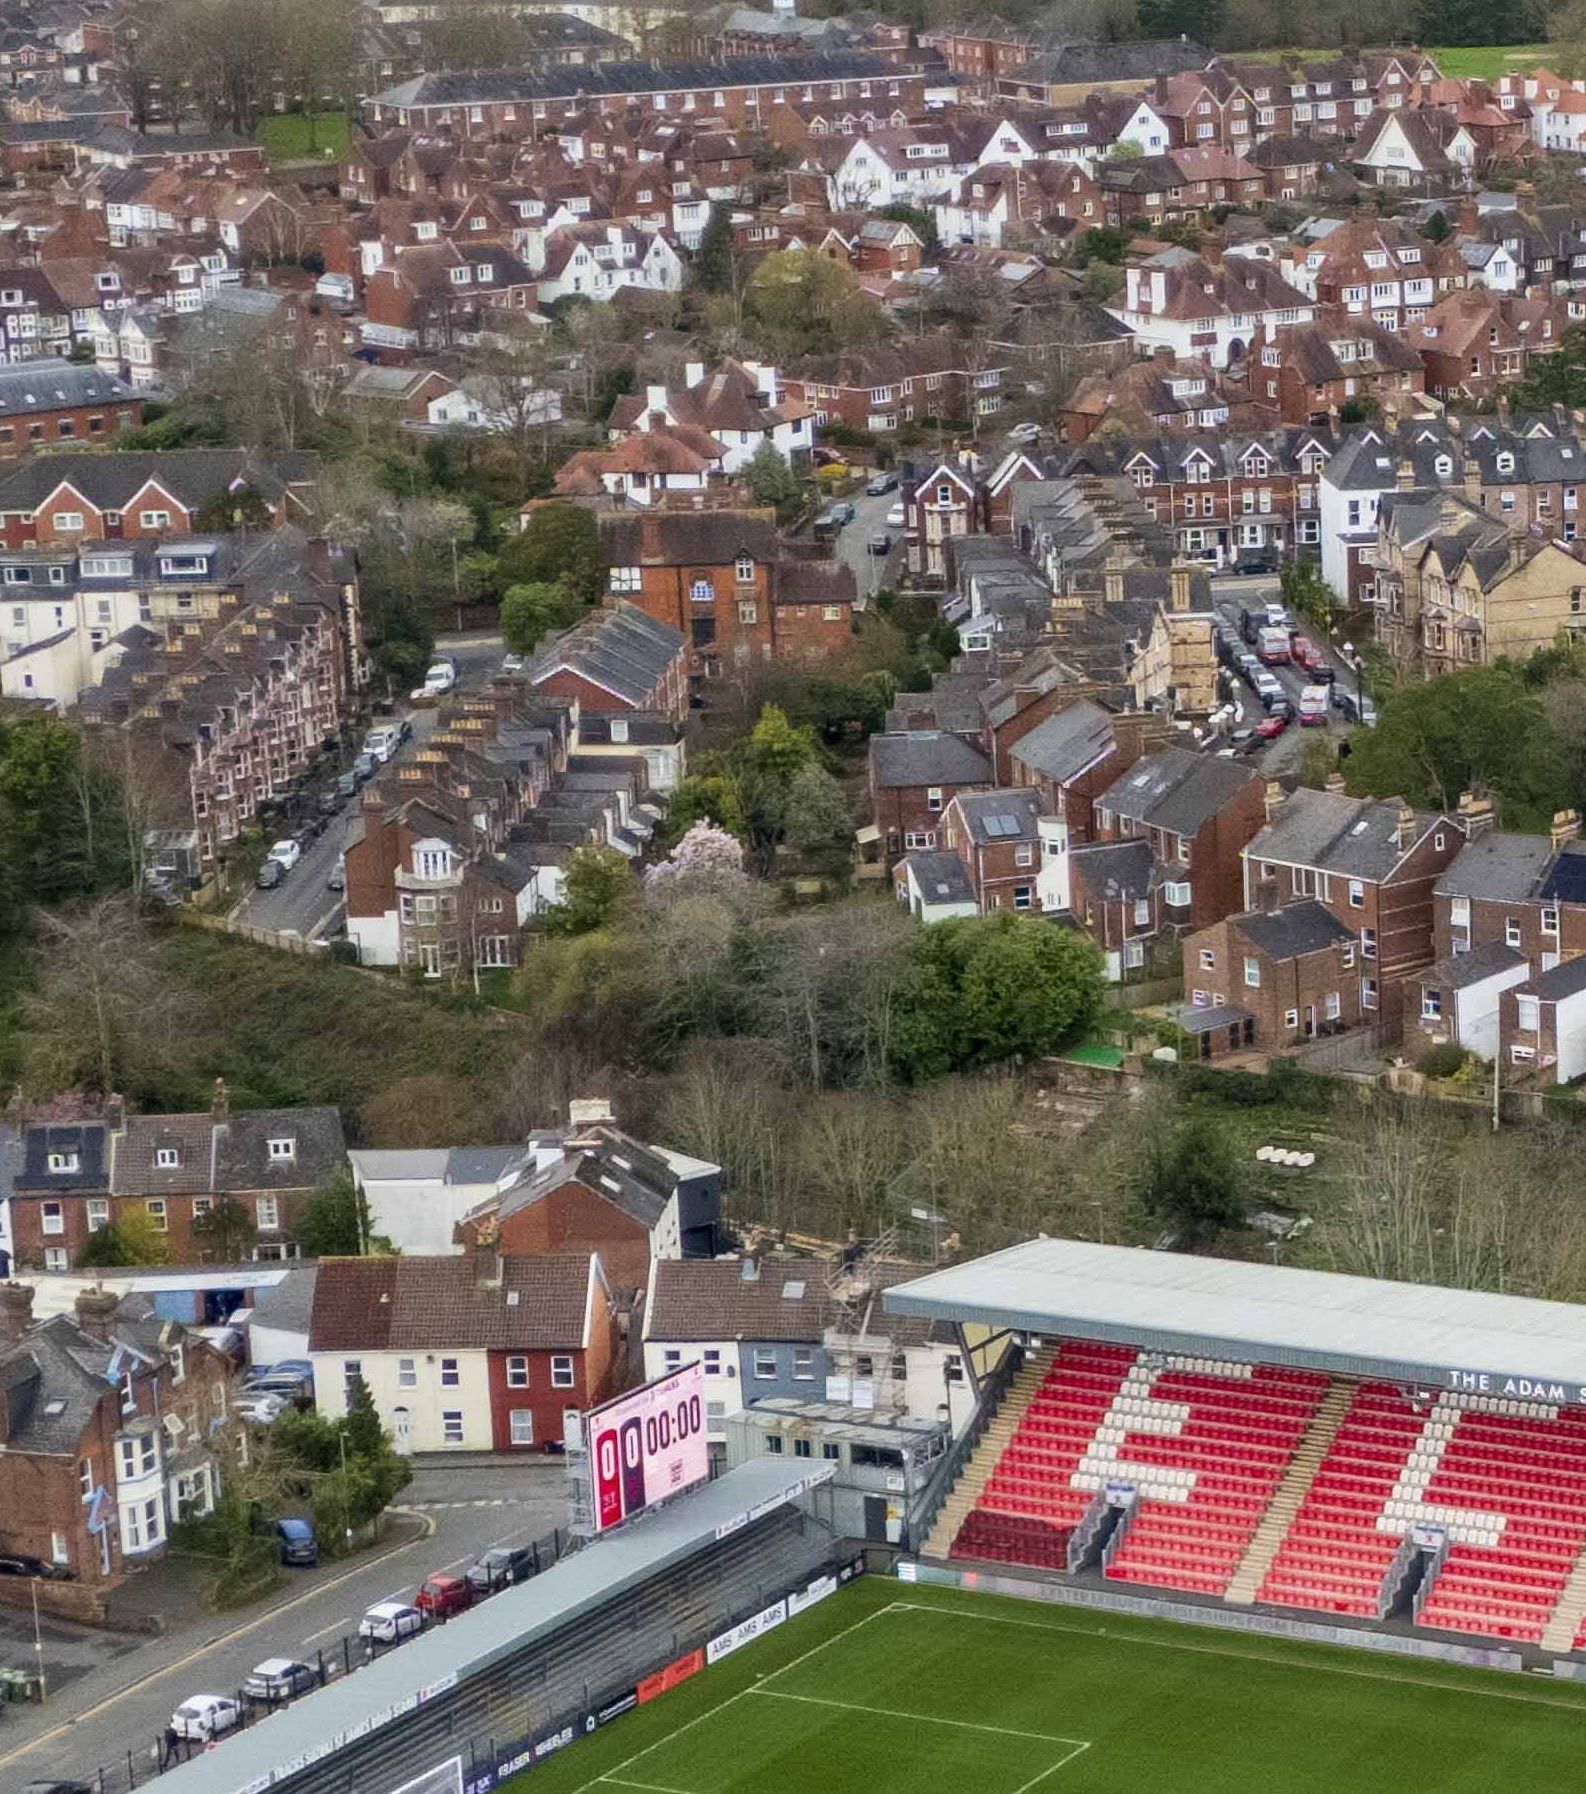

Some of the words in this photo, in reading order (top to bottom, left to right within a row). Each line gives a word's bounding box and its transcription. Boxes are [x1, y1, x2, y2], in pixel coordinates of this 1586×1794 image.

[1450, 1370, 1489, 1391] THE
[1503, 1377, 1565, 1399] ADAM
[601, 1438, 615, 1481] 0
[646, 1394, 701, 1456] 00:00
[714, 1635, 731, 1653] AMS
[738, 1621, 756, 1640] AMS
[763, 1607, 781, 1626] AMS
[1247, 1616, 1285, 1631] FROM
[498, 1752, 530, 1778] FRASER
[535, 1727, 573, 1756] WHEELER
